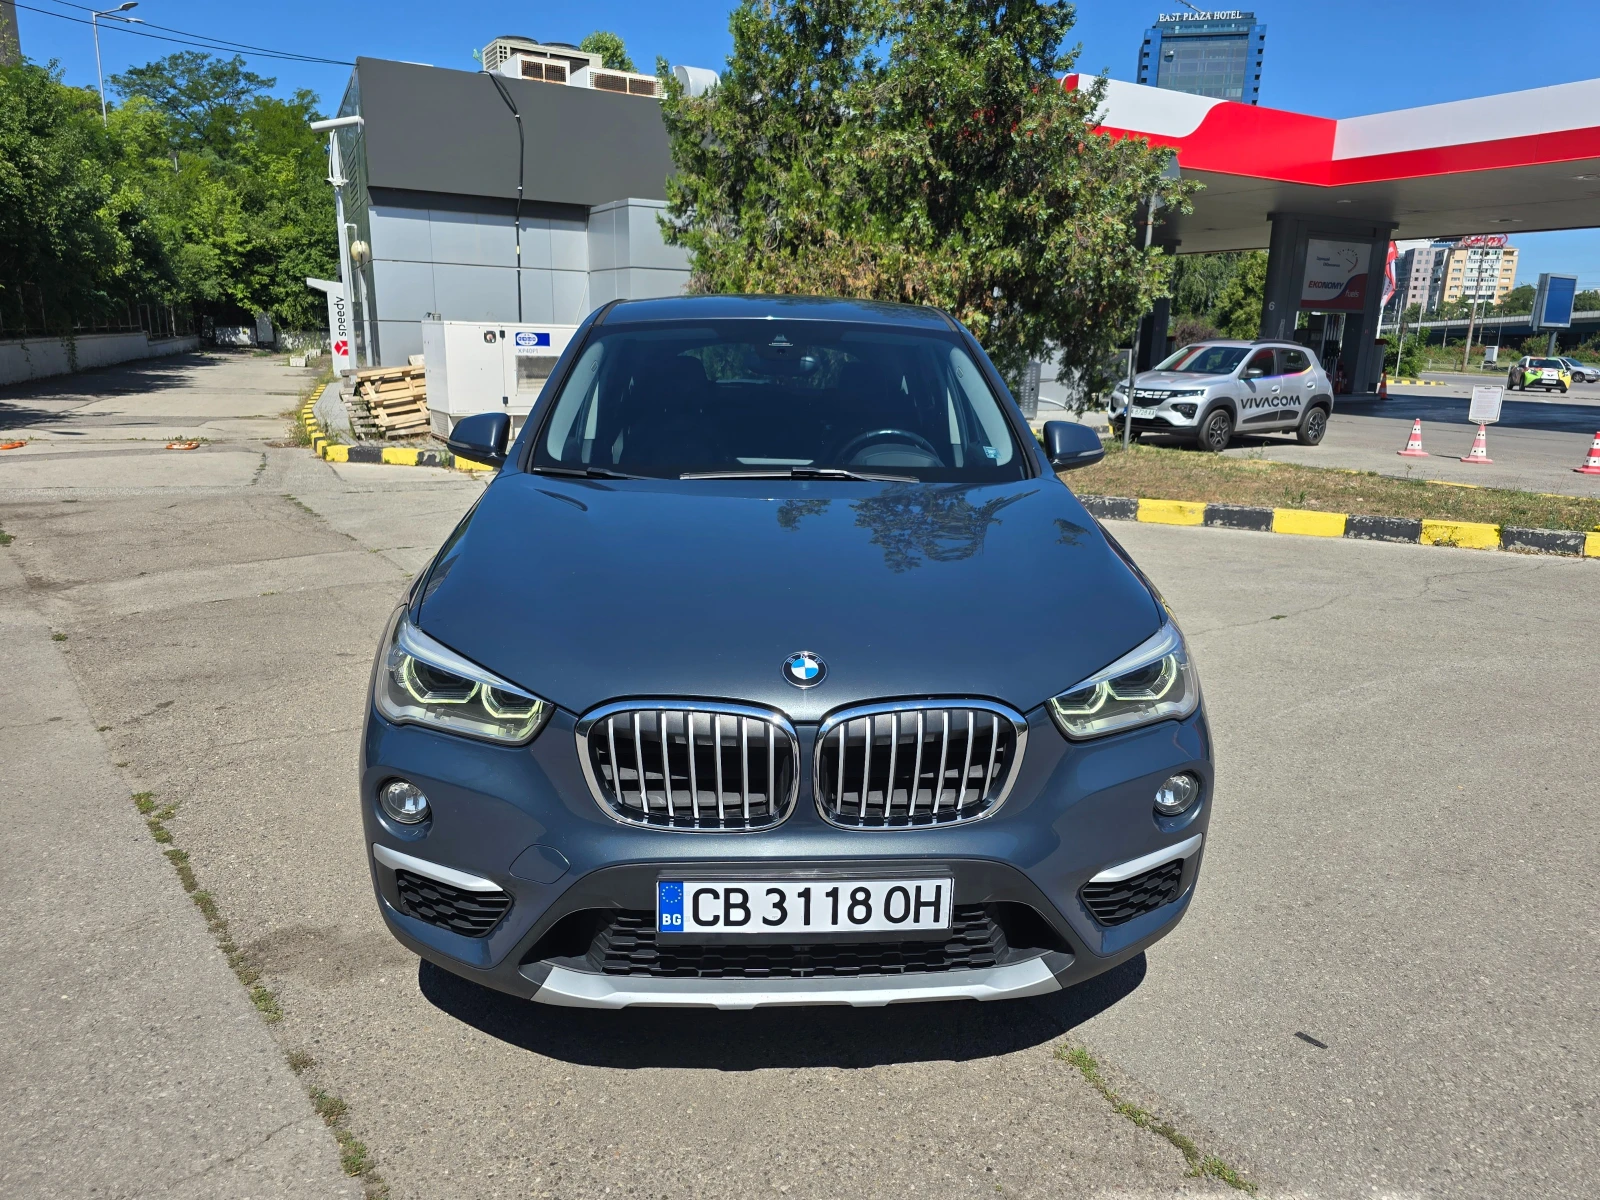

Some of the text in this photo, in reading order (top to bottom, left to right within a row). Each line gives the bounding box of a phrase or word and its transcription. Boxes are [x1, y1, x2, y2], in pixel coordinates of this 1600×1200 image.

[1159, 10, 1242, 21] EAST PLAZA HOTEL
[1308, 280, 1345, 290] EKONOMY
[1345, 289, 1360, 298] fuels
[1268, 301, 1276, 311] 6
[333, 296, 347, 337] speedy
[1240, 395, 1301, 409] VIVACOM
[692, 884, 942, 927] CB 3118 OH
[662, 913, 682, 926] BG
